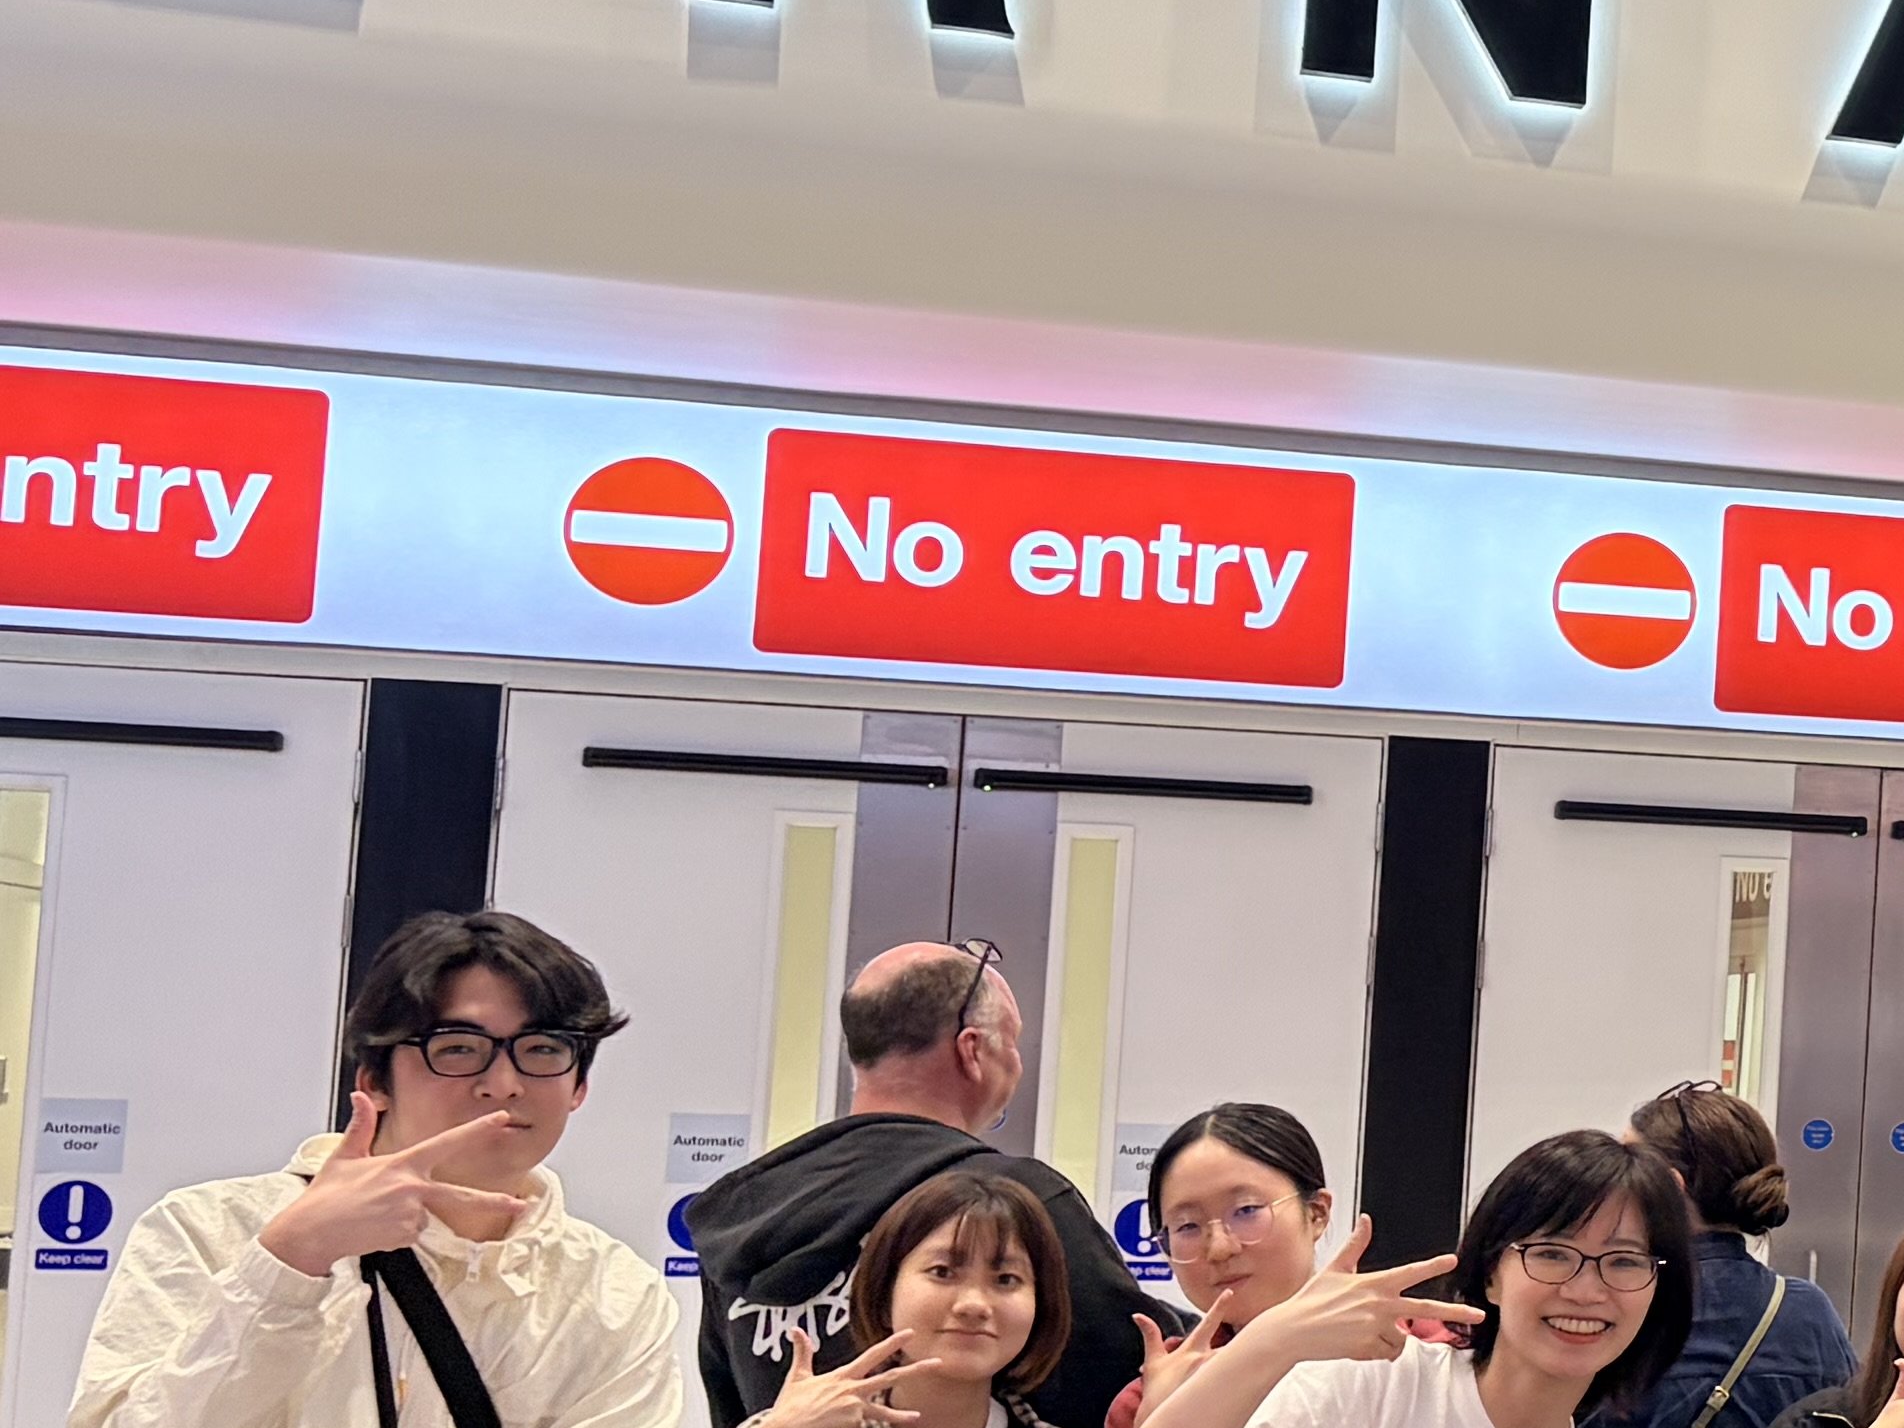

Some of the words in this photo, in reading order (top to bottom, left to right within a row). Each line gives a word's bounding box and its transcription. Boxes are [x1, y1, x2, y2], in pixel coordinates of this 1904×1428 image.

[804, 491, 965, 588] No
[1009, 523, 1309, 630] entry
[1756, 563, 1894, 651] No
[43, 1121, 121, 1135] Automatic
[63, 1139, 99, 1151] door
[673, 1134, 745, 1148] Automatic
[691, 1151, 725, 1163] door
[38, 1253, 71, 1266] Keep
